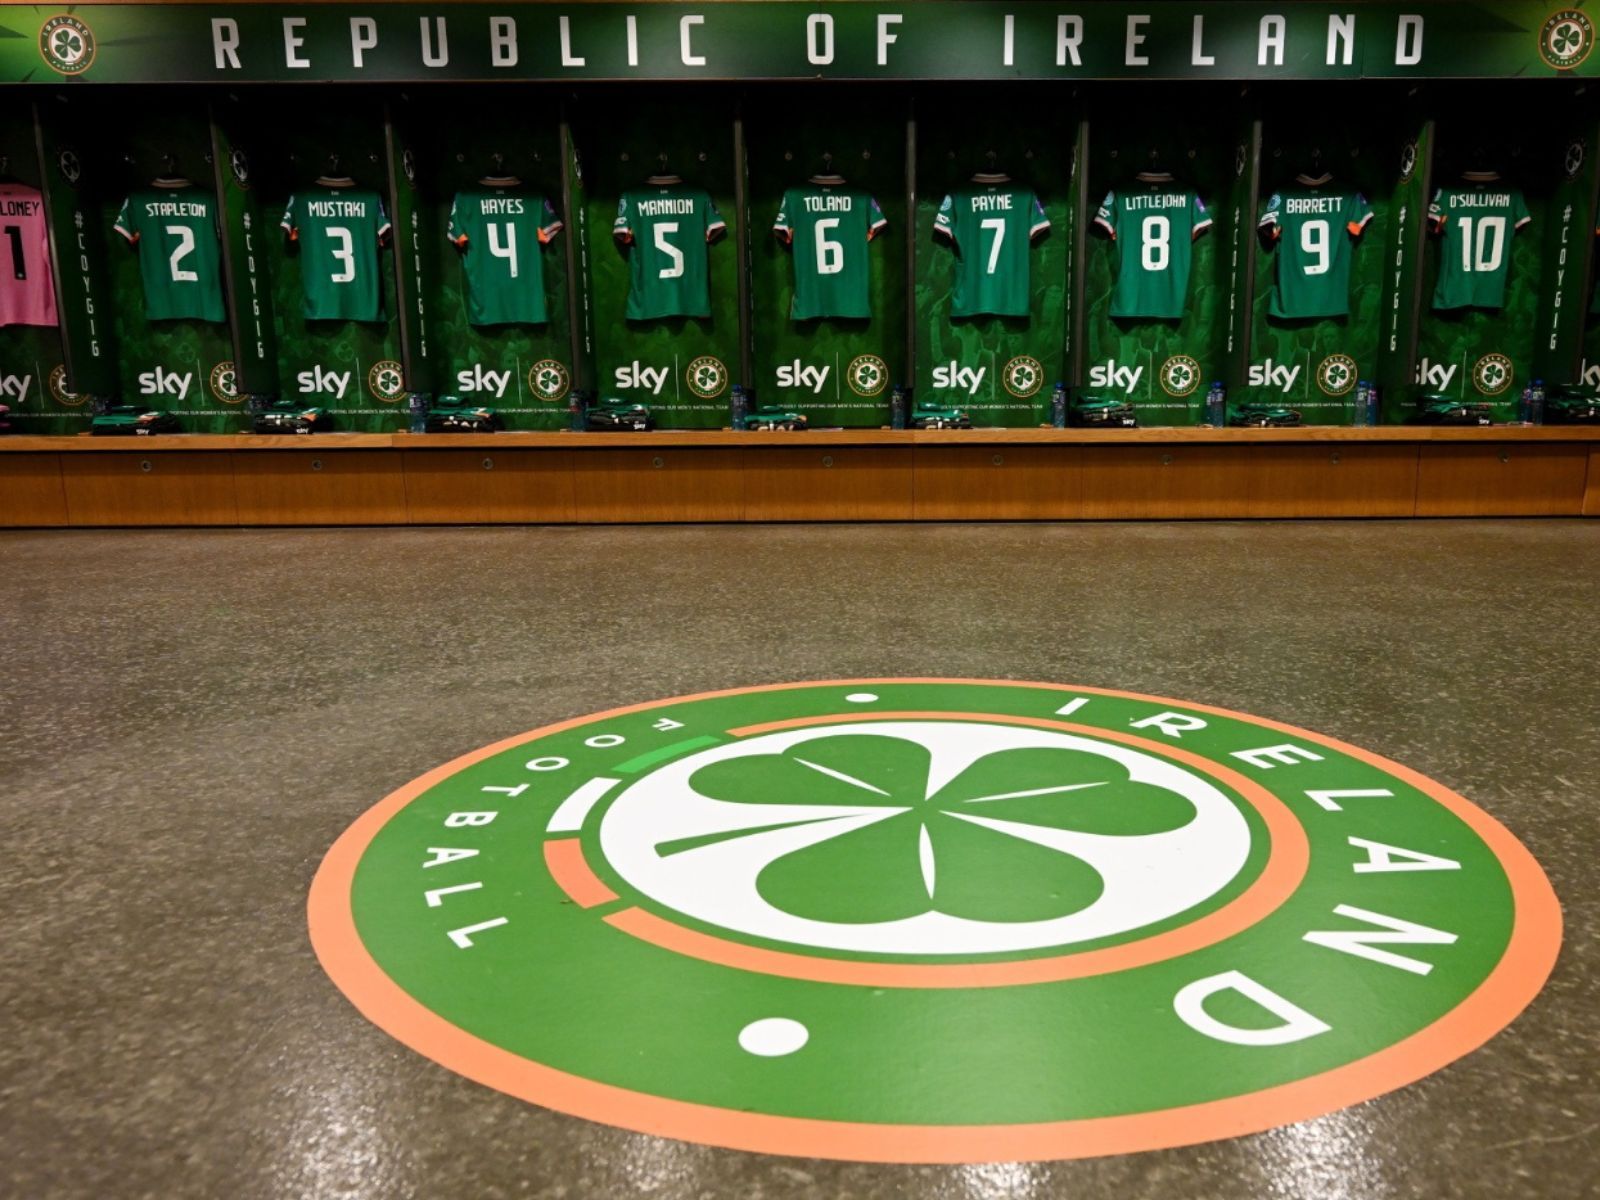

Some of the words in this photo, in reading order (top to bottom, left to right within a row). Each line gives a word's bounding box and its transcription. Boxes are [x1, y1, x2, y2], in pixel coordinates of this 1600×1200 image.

[211, 14, 707, 70] REPUBLIC
[806, 14, 903, 66] OF
[1003, 14, 1424, 67] IRELAND
[145, 202, 206, 218] STAPLETON
[308, 201, 366, 218] MUSTAKI
[480, 199, 524, 215] HAYES
[637, 199, 694, 217] MANNION
[804, 196, 852, 212] TOLAND
[971, 194, 1013, 213] PAYNE
[1125, 194, 1187, 211] LITTLEJOHN
[1286, 196, 1343, 214] BARRETT
[1450, 193, 1511, 208] O'SULLIVAN
[4, 225, 27, 280] 1
[165, 225, 199, 282] 2
[325, 226, 356, 283] 3
[487, 222, 518, 278] 4
[653, 222, 685, 279] 5
[814, 217, 844, 274] 6
[980, 218, 1006, 274] 7
[1141, 215, 1170, 271] 8
[1300, 219, 1330, 275] 9
[1458, 216, 1506, 272] 10
[138, 365, 193, 400] sky
[297, 364, 351, 399] sky
[457, 363, 512, 398] sky
[615, 360, 669, 395] sky
[776, 358, 830, 394] sky
[932, 360, 987, 395] sky
[1089, 359, 1144, 394] sky
[1248, 358, 1301, 393] sky
[422, 717, 685, 949] FOOTBALL
[1055, 697, 1462, 1046] IRELAND
